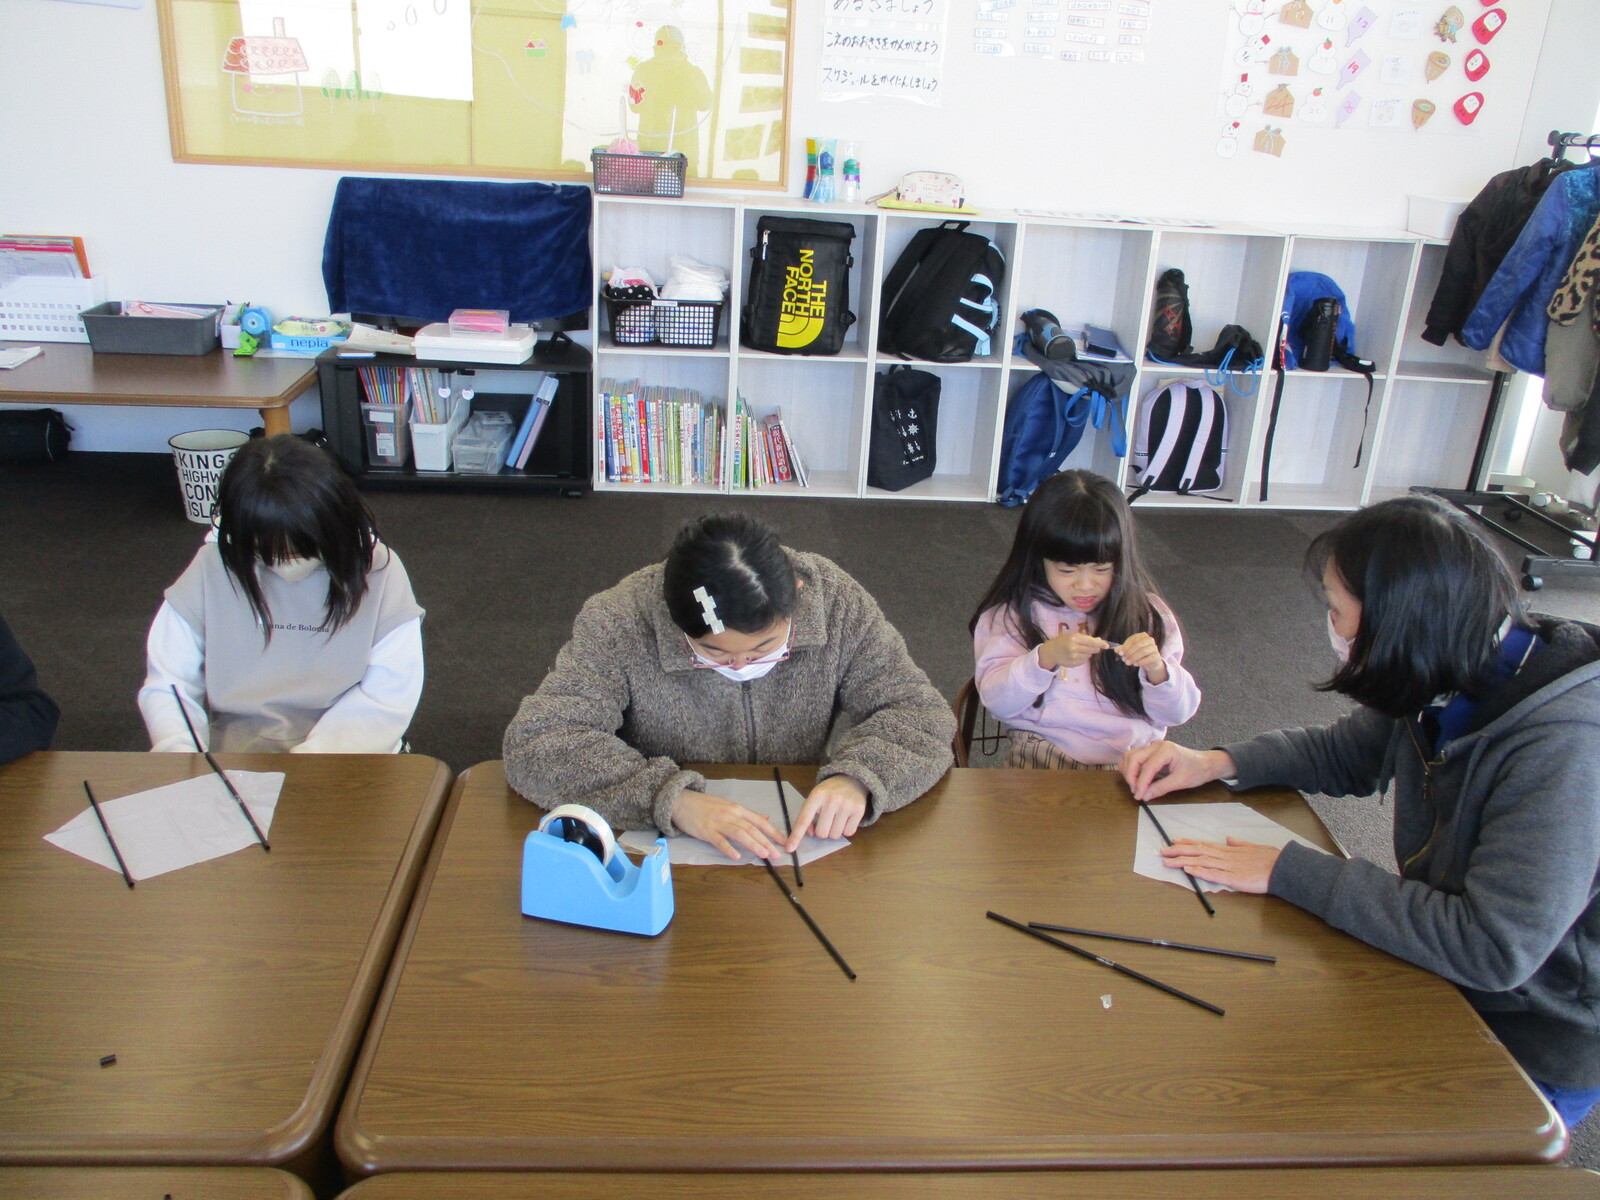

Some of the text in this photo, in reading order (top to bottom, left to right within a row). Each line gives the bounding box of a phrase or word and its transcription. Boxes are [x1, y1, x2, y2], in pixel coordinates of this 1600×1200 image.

[1357, 17, 1369, 29] 12
[826, 31, 939, 56] こえのおおきさをかんがえよう
[822, 67, 938, 93] スケジュールをかくにんしましょう
[1347, 61, 1360, 74] 19
[781, 266, 800, 315] FACE
[795, 249, 816, 317] NORTH
[810, 280, 828, 318] THE
[290, 338, 329, 349] nepia
